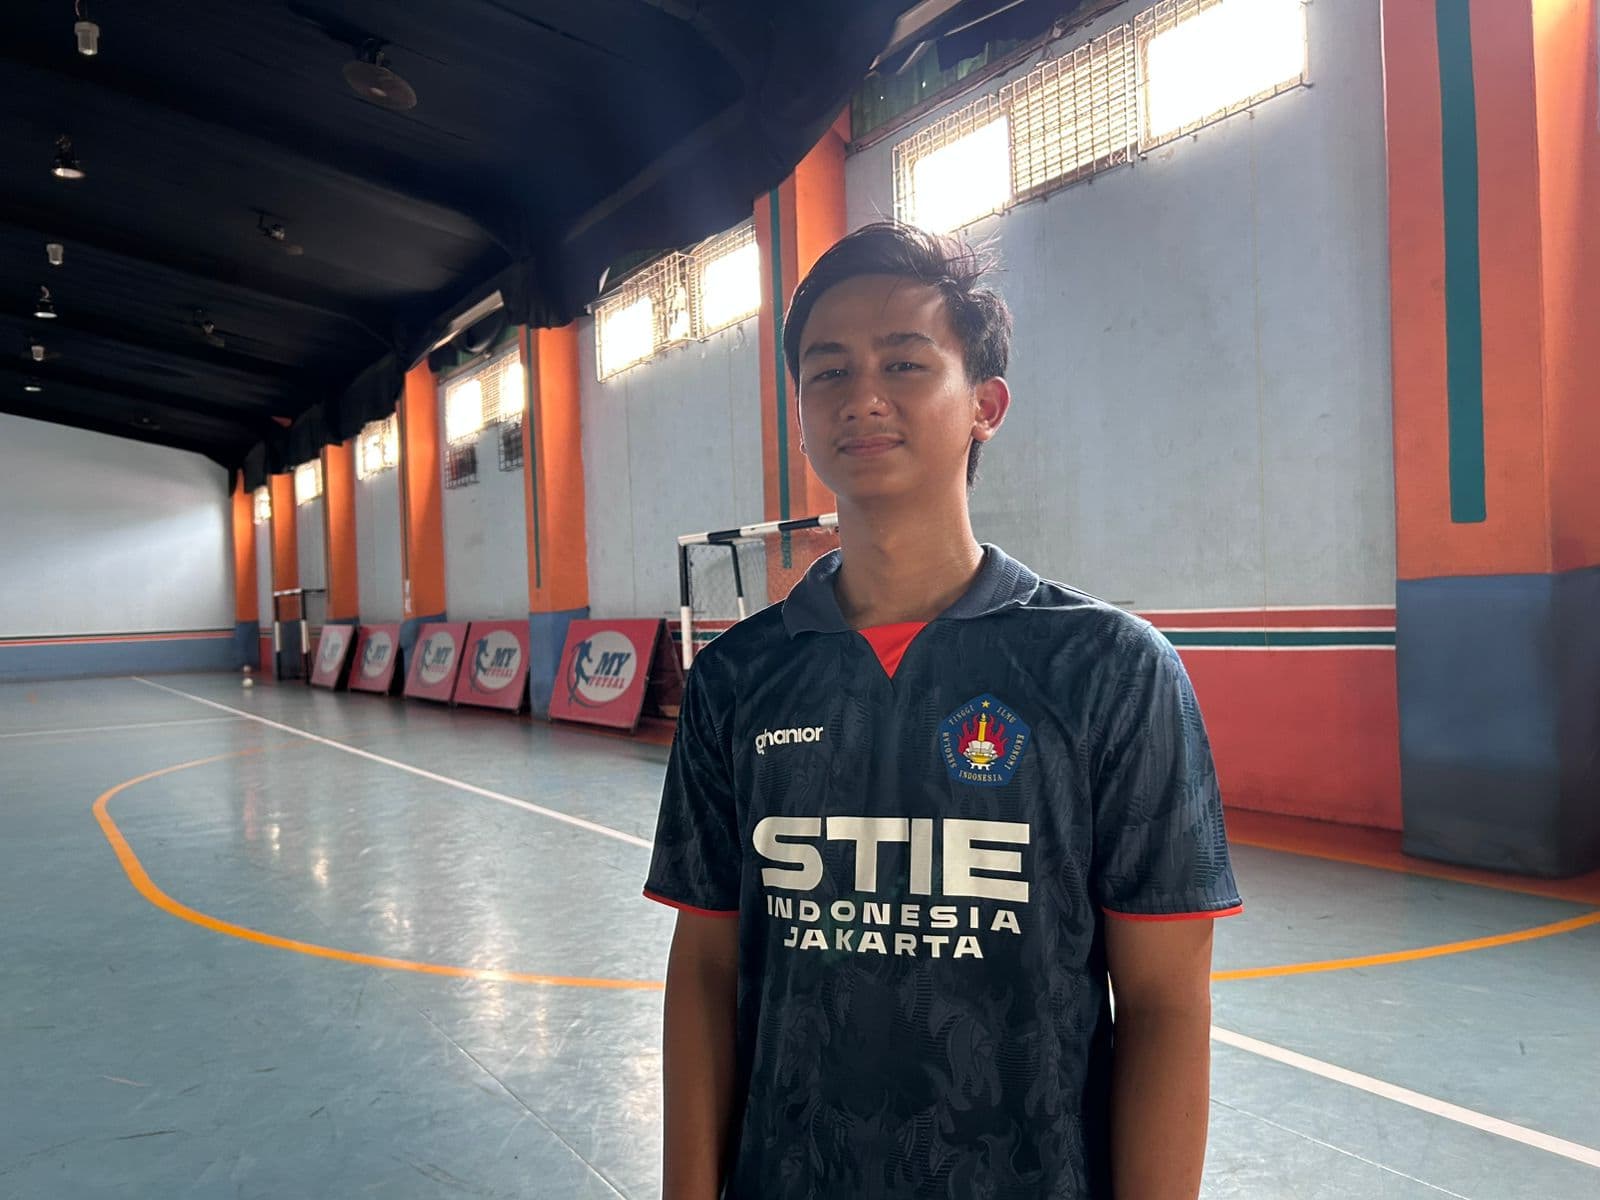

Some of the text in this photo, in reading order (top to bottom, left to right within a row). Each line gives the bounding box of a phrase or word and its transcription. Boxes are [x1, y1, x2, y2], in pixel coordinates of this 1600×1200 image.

[491, 647, 517, 667] MY
[594, 652, 631, 676] MY
[588, 676, 625, 689] FUTSAL
[755, 726, 824, 755] ghanior
[943, 704, 1025, 770] SEKOLAH TINGGI ILMU EKONOMI
[959, 769, 1003, 782] INDONESIA
[753, 816, 1030, 903] STIE
[767, 895, 1022, 934] INDONESIA
[784, 926, 984, 959] JAKARTA
